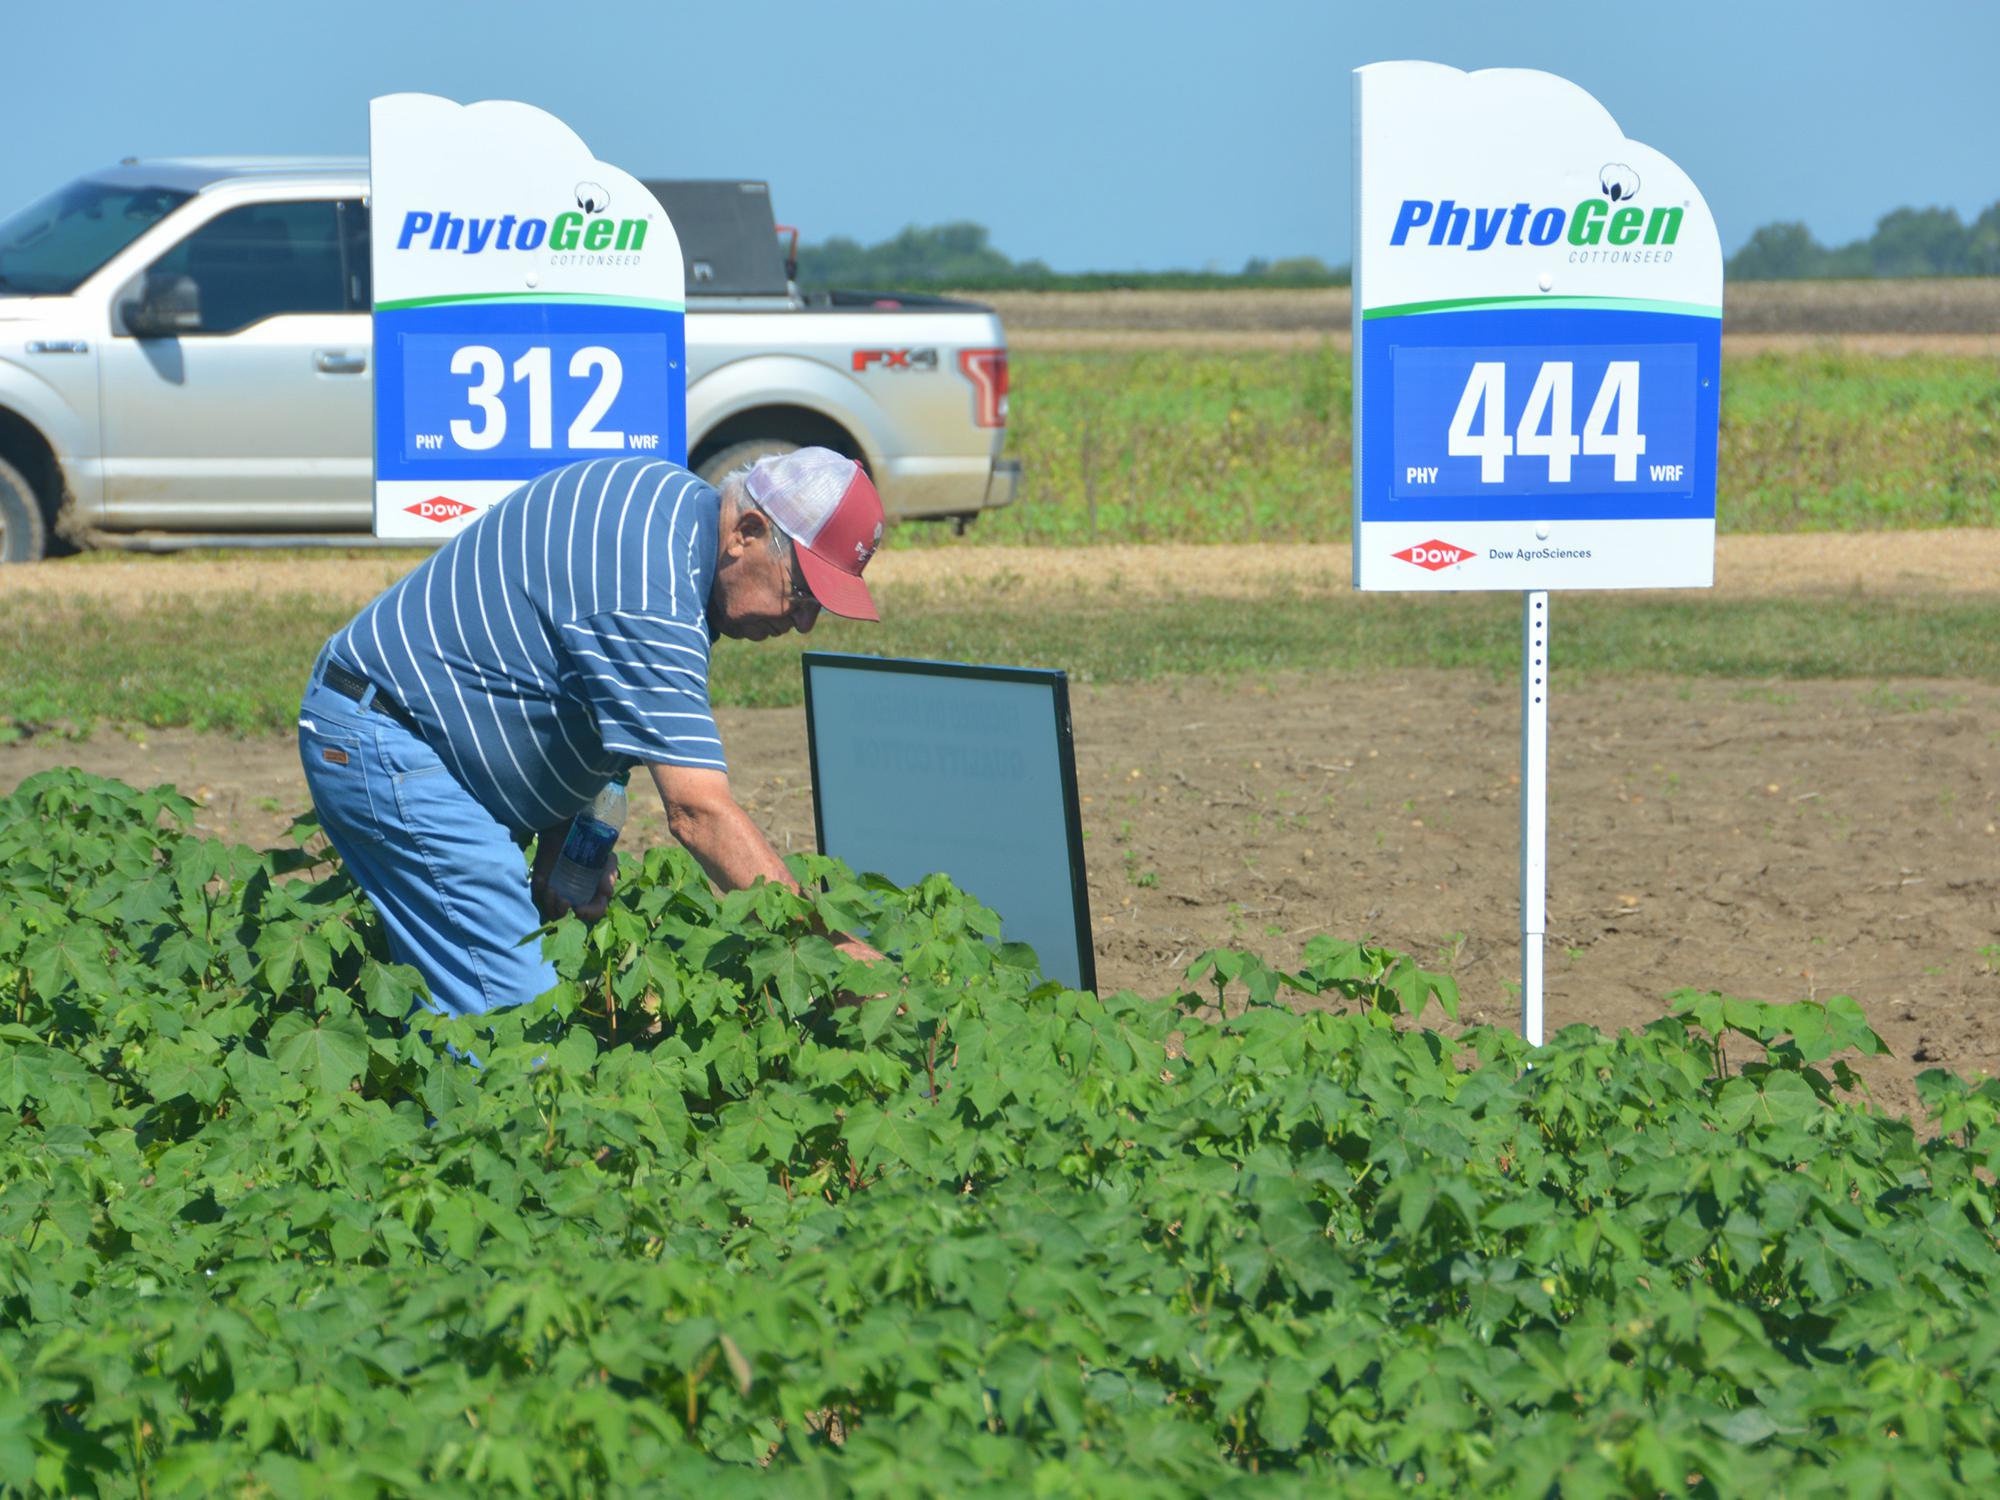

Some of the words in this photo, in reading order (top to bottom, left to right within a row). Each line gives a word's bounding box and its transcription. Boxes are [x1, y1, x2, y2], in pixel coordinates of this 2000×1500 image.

[396, 211, 648, 254] PhytoGen
[1389, 199, 1685, 251] PhytoGen
[550, 255, 641, 266] COTTONSEED
[1569, 251, 1673, 263] COTTONSEED
[852, 349, 938, 372] FX4
[416, 435, 443, 449] PHY
[450, 345, 624, 450] 312
[629, 434, 659, 449] WRF
[1407, 467, 1438, 484] PHY
[1448, 361, 1646, 483] 444
[1650, 465, 1683, 482] WRF
[1489, 549, 1513, 559] Dow
[1517, 548, 1591, 561] AgroSciences
